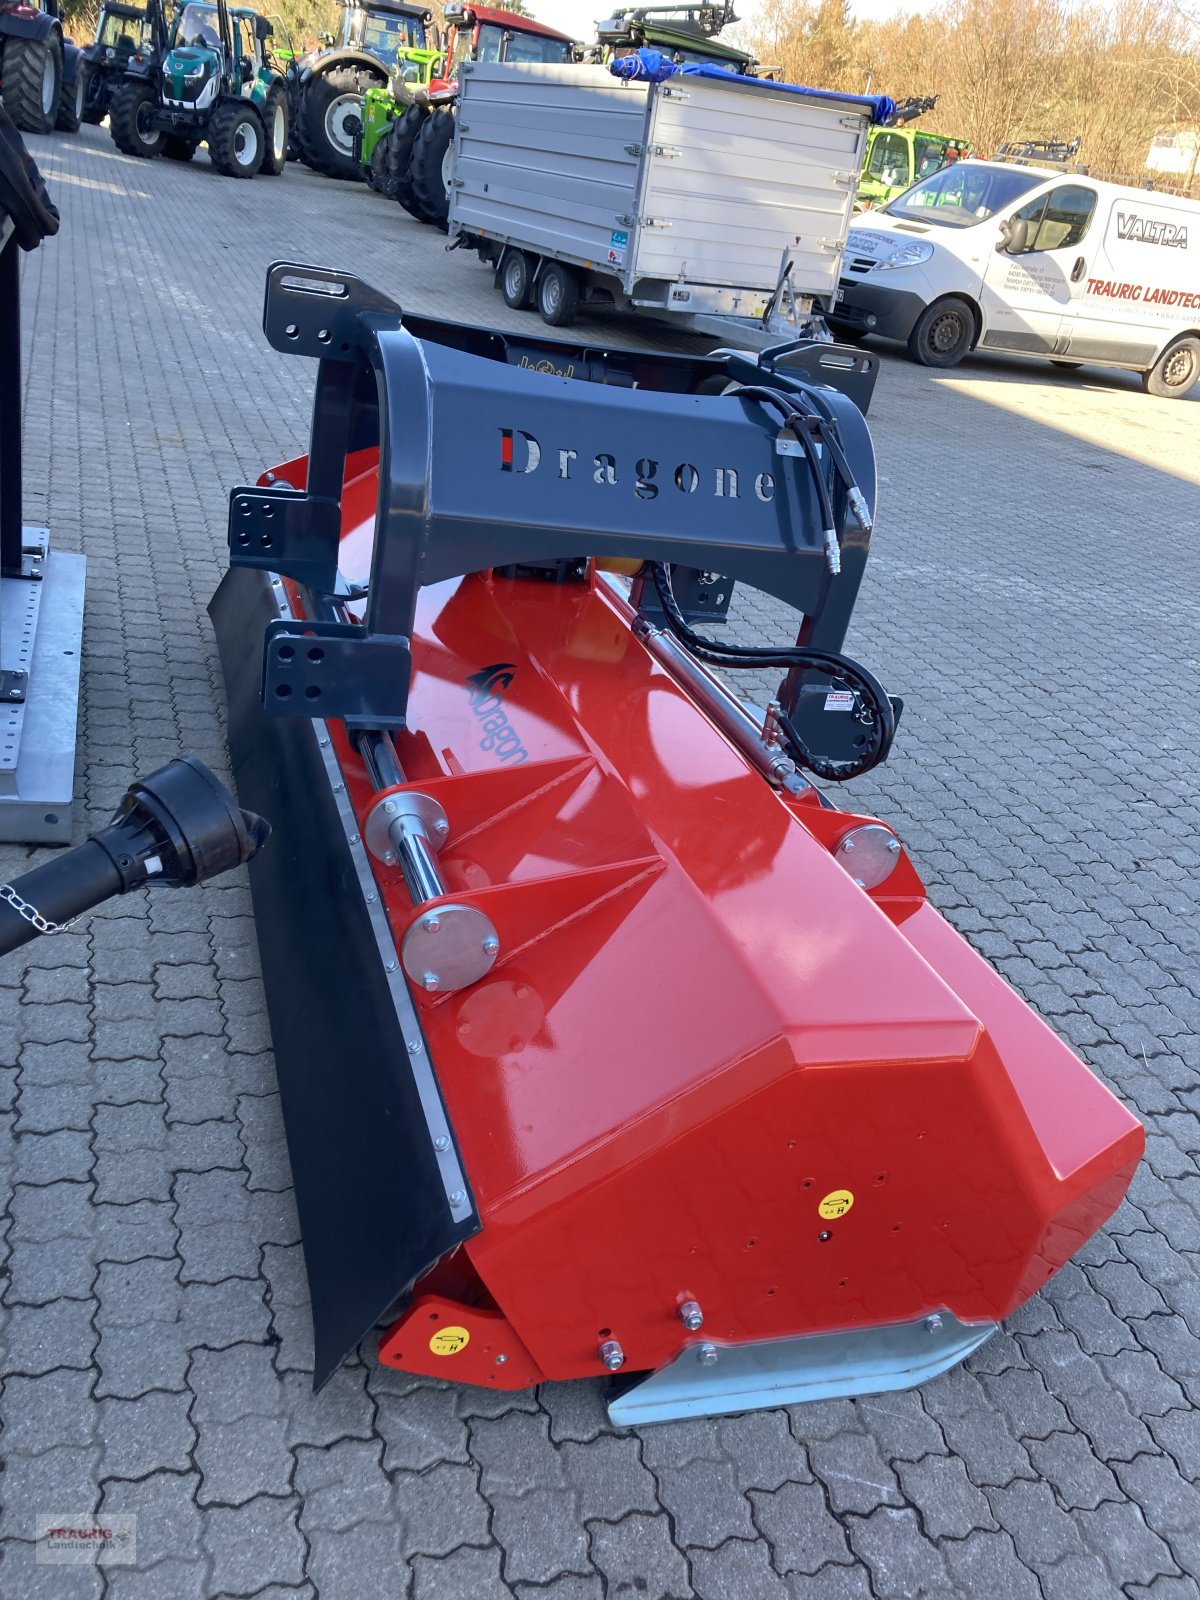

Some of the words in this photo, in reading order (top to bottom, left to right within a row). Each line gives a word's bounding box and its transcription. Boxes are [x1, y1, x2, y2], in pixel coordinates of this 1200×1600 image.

[848, 235, 878, 253] ALTRA
[1117, 212, 1187, 249] VALTRA
[1086, 278, 1142, 301] TRAURIG
[498, 427, 776, 502] Dragone
[470, 692, 528, 765] Dragon
